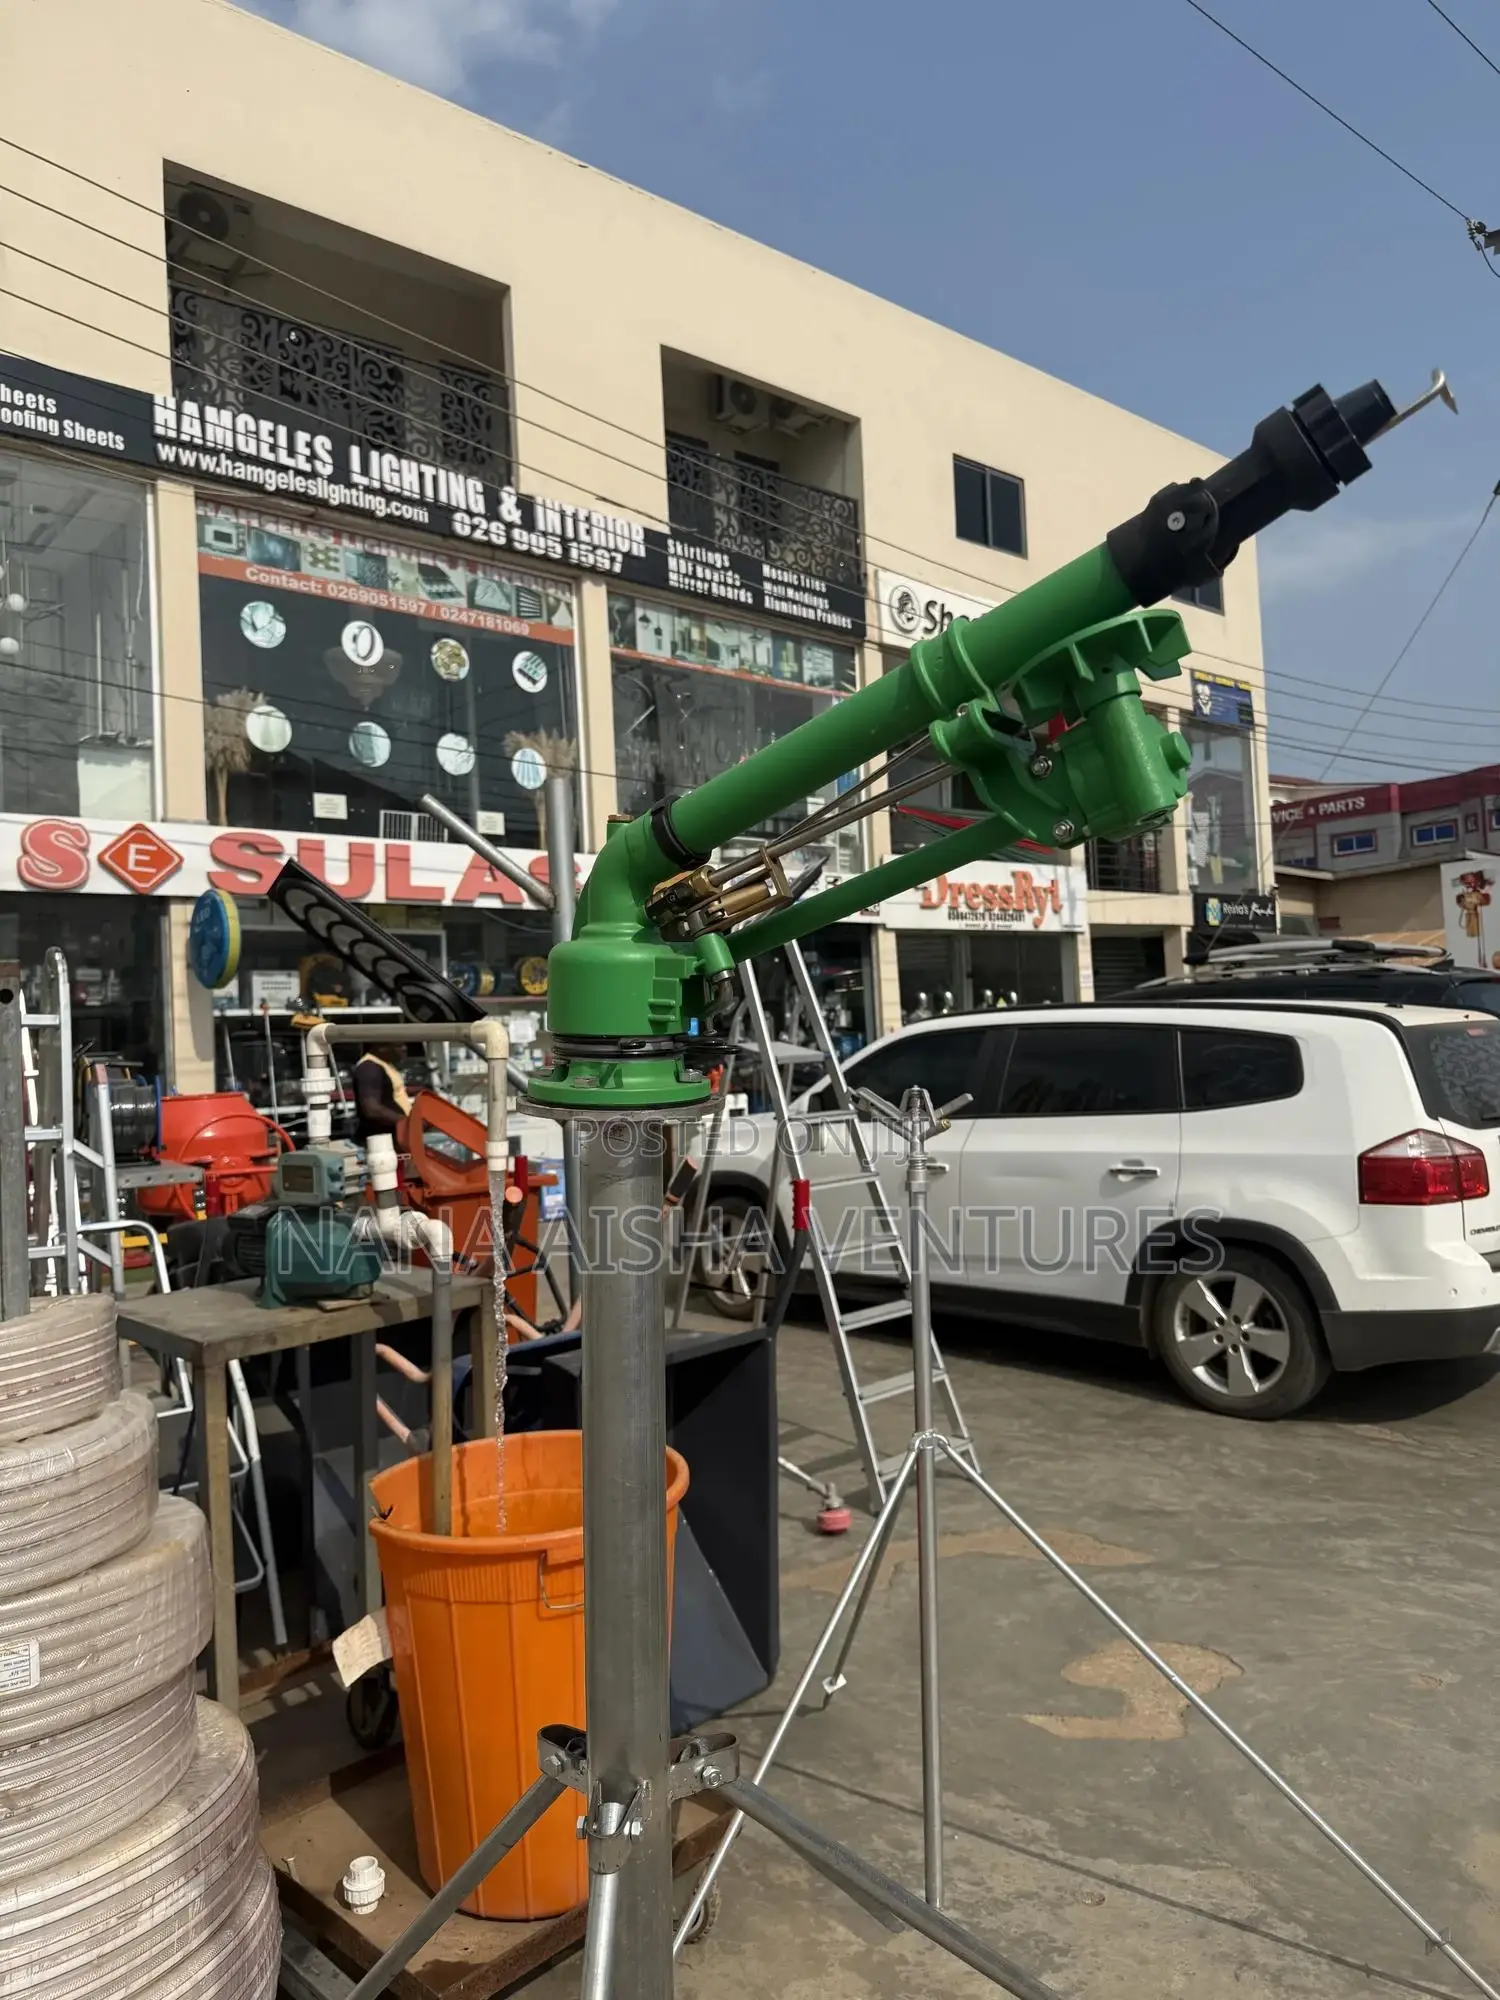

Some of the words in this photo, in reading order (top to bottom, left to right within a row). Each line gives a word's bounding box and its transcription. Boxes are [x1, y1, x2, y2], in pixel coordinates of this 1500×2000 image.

[62, 419, 125, 451] Sheets
[153, 393, 335, 476] HAMGELES
[349, 444, 486, 515] LIGHTING
[499, 485, 523, 526] &
[534, 495, 647, 558] INTERIOR
[156, 442, 430, 524] www.hamgeleslighting.com
[667, 537, 731, 569] Skirtings
[245, 566, 323, 594] Contact:
[327, 583, 426, 614] 0269051597
[668, 571, 710, 595] Mirror
[710, 581, 754, 605] Boards
[762, 563, 799, 585] Mosaic
[1318, 796, 1366, 816] PARTS
